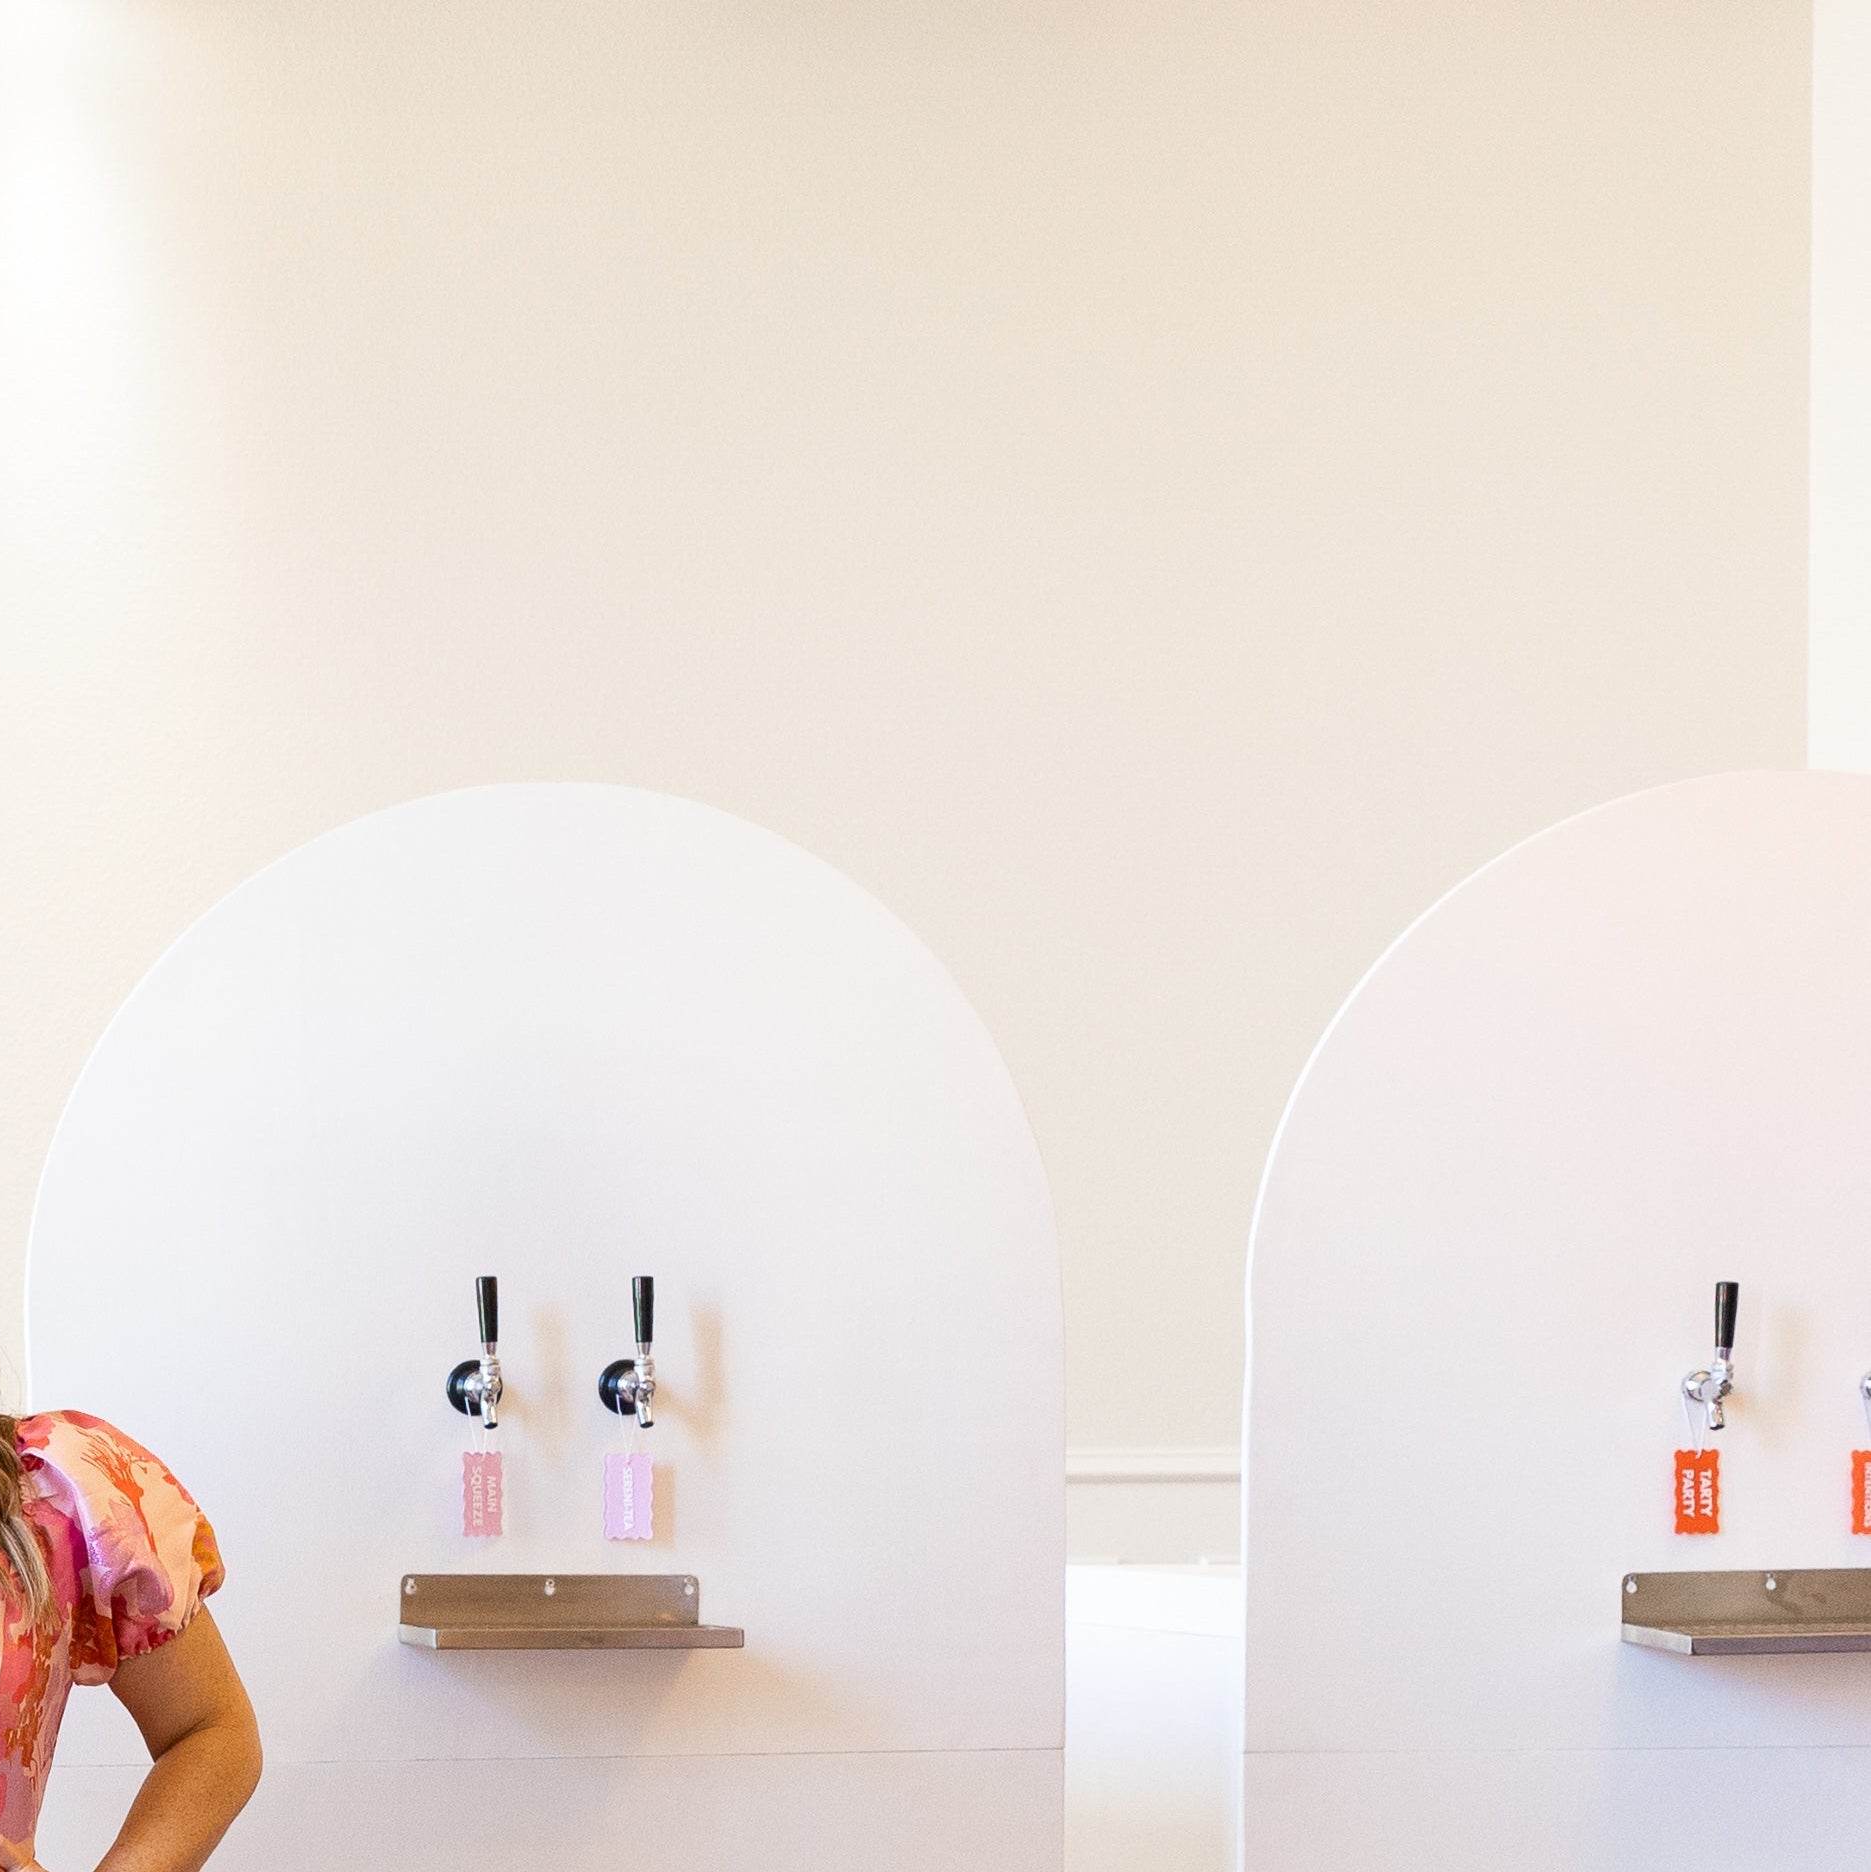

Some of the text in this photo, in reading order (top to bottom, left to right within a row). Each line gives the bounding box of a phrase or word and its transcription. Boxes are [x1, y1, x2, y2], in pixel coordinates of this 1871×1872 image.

[471, 1466, 484, 1527] SQUEEZE
[487, 1475, 498, 1513] MAIN
[1682, 1469, 1695, 1518] PARTY
[1700, 1469, 1713, 1517] TARTY
